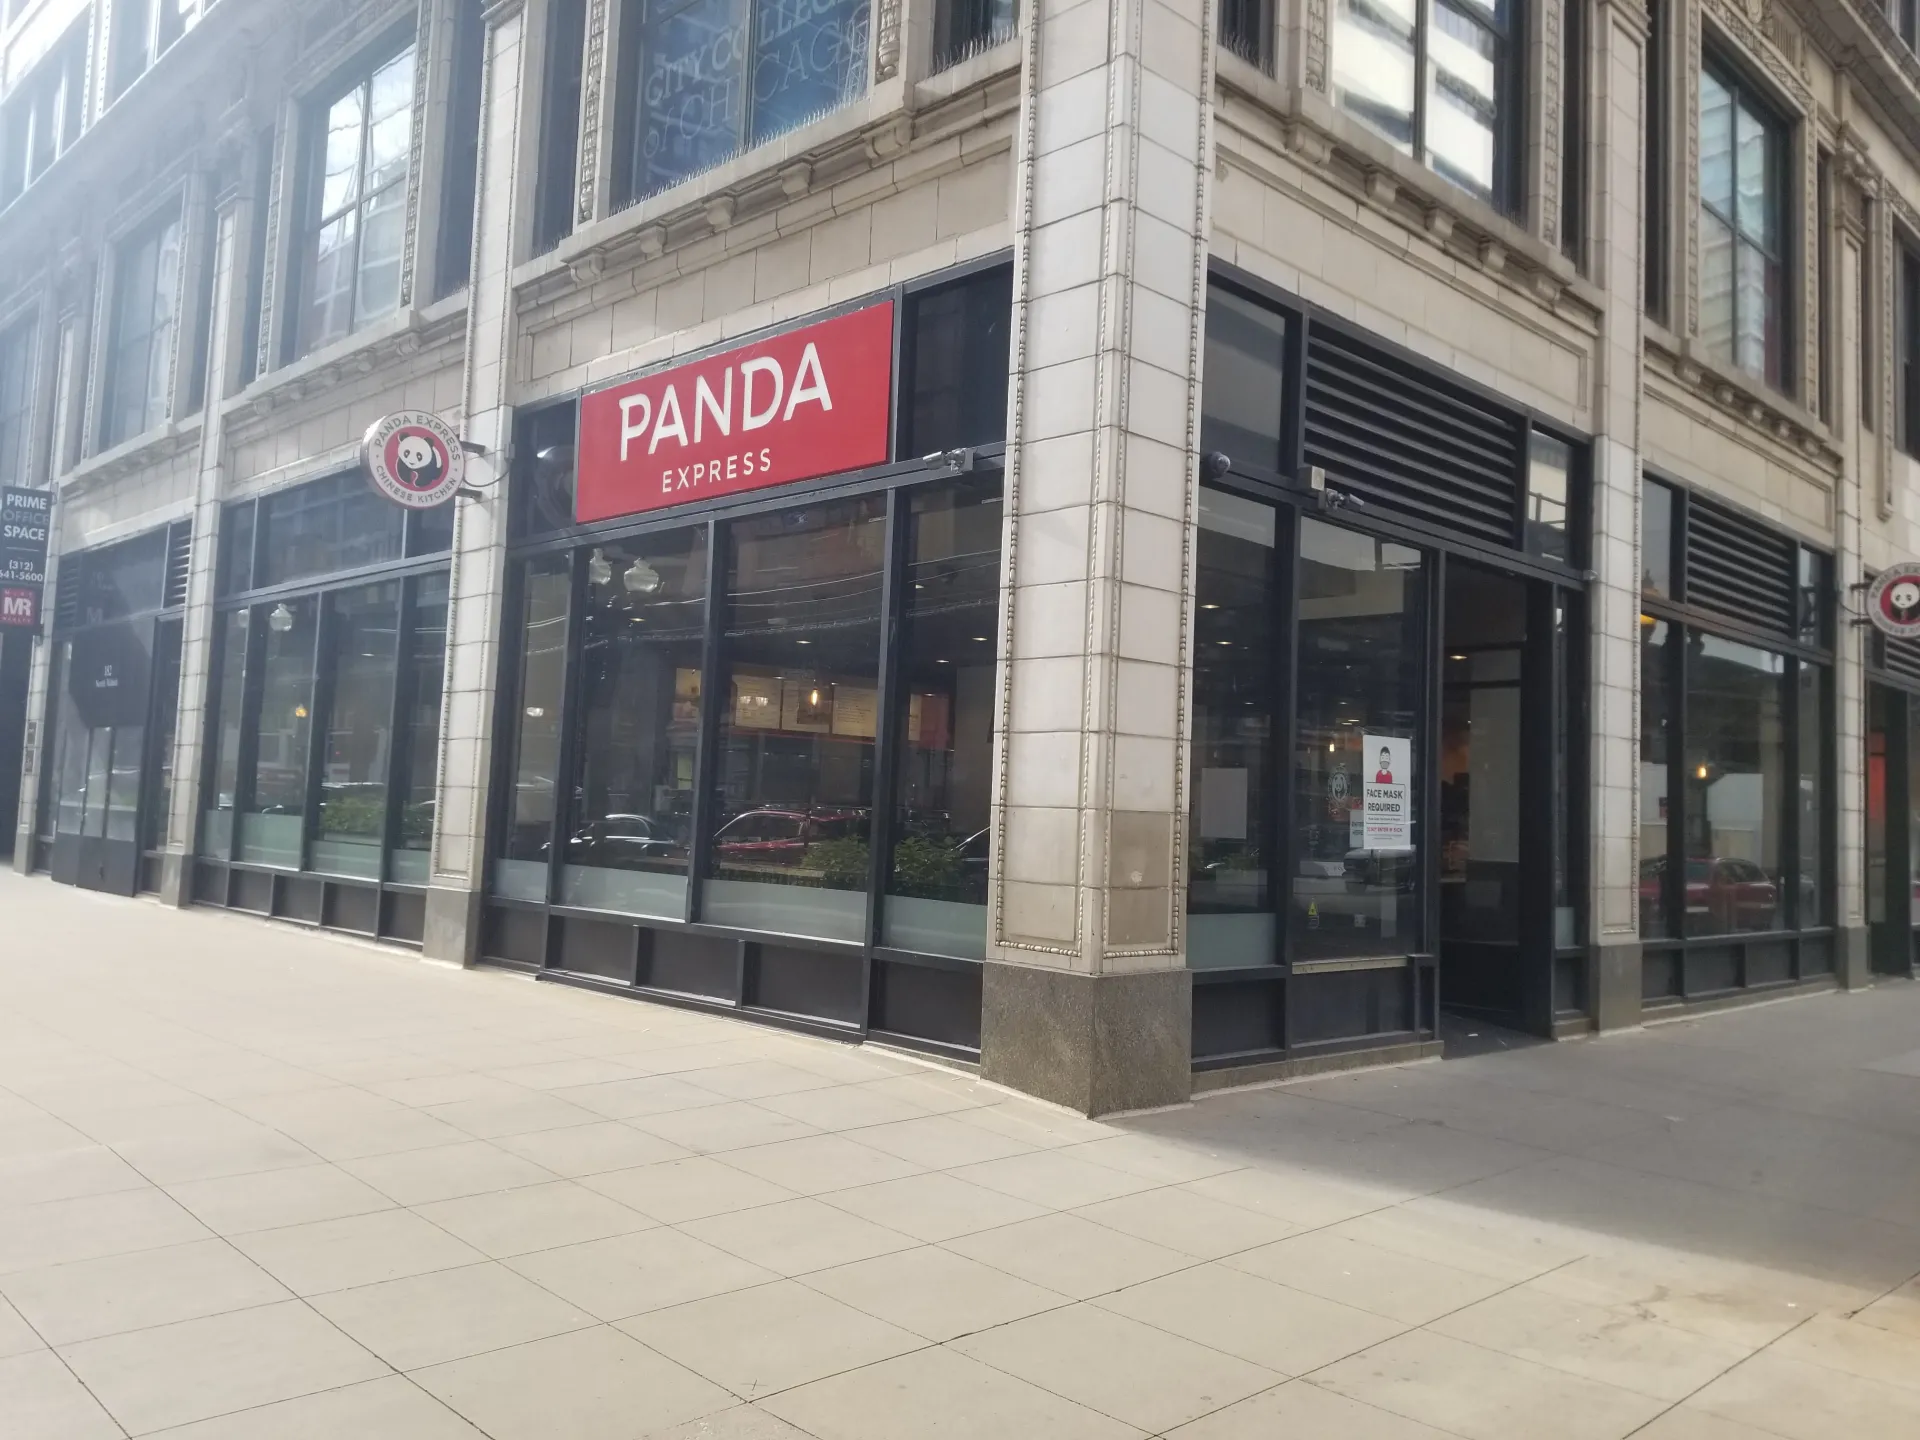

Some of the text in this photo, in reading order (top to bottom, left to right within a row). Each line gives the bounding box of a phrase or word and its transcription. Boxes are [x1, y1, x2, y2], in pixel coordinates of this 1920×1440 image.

[645, 44, 709, 108] CITY
[618, 341, 833, 462] PANDA
[375, 414, 461, 461] PANDA EXPRESS
[661, 447, 772, 493] EXPRESS
[376, 465, 457, 503] CHINESE KITCHEN
[6, 493, 48, 510] PRIME
[2, 509, 50, 526] OFFICE
[3, 525, 45, 541] SPACE
[9, 559, 34, 571] (312)
[3, 596, 32, 617] MR
[1366, 788, 1403, 799] FACE MASK
[1368, 802, 1401, 812] REQUIRED
